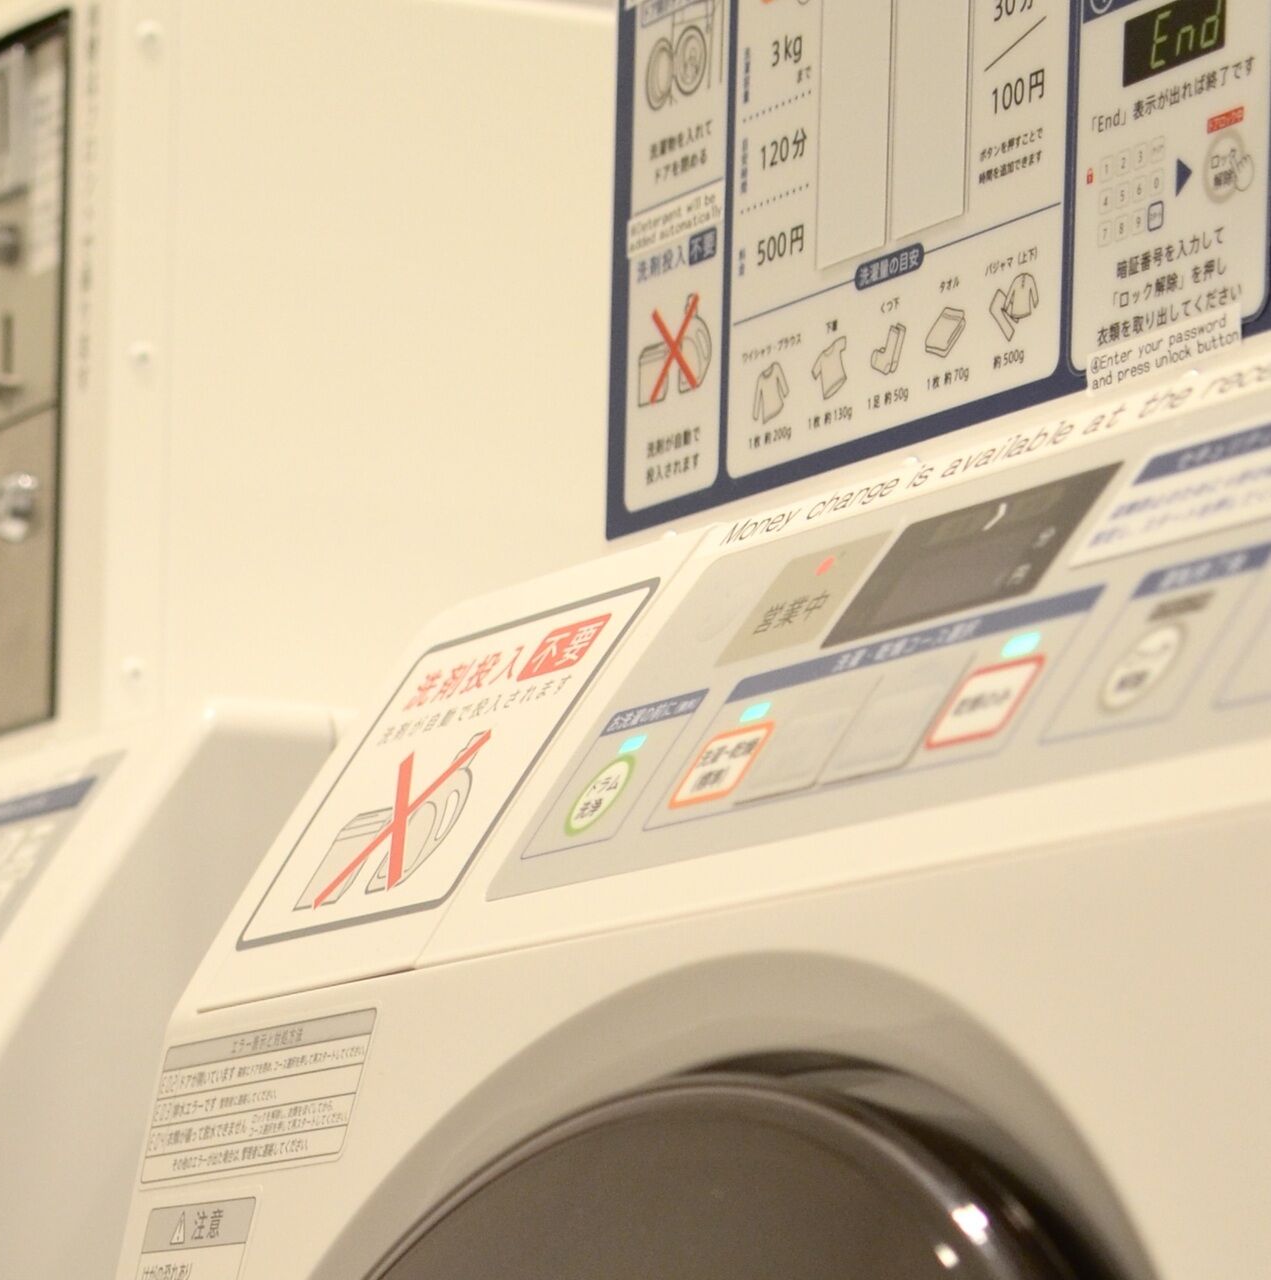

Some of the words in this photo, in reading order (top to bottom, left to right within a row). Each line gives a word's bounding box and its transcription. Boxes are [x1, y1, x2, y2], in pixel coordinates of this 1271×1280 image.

[1150, 0, 1223, 70] End
[991, 68, 1045, 115] 100円
[761, 128, 808, 170] 120分
[757, 224, 804, 266] 500円
[1116, 226, 1225, 279] 暗証番号を入力して
[1097, 284, 1243, 347] 衣類を取り出してください
[1138, 338, 1163, 358] your
[1169, 313, 1227, 346] password
[1092, 372, 1113, 390] and
[1117, 361, 1150, 383] press
[1155, 347, 1192, 369] unlock
[1198, 331, 1239, 354] button
[720, 506, 801, 545] Money
[806, 478, 900, 521] change
[909, 463, 935, 487] is
[941, 419, 1074, 478] available
[1083, 405, 1126, 435] at
[1138, 383, 1193, 418] the
[191, 1208, 224, 1241] 注意
